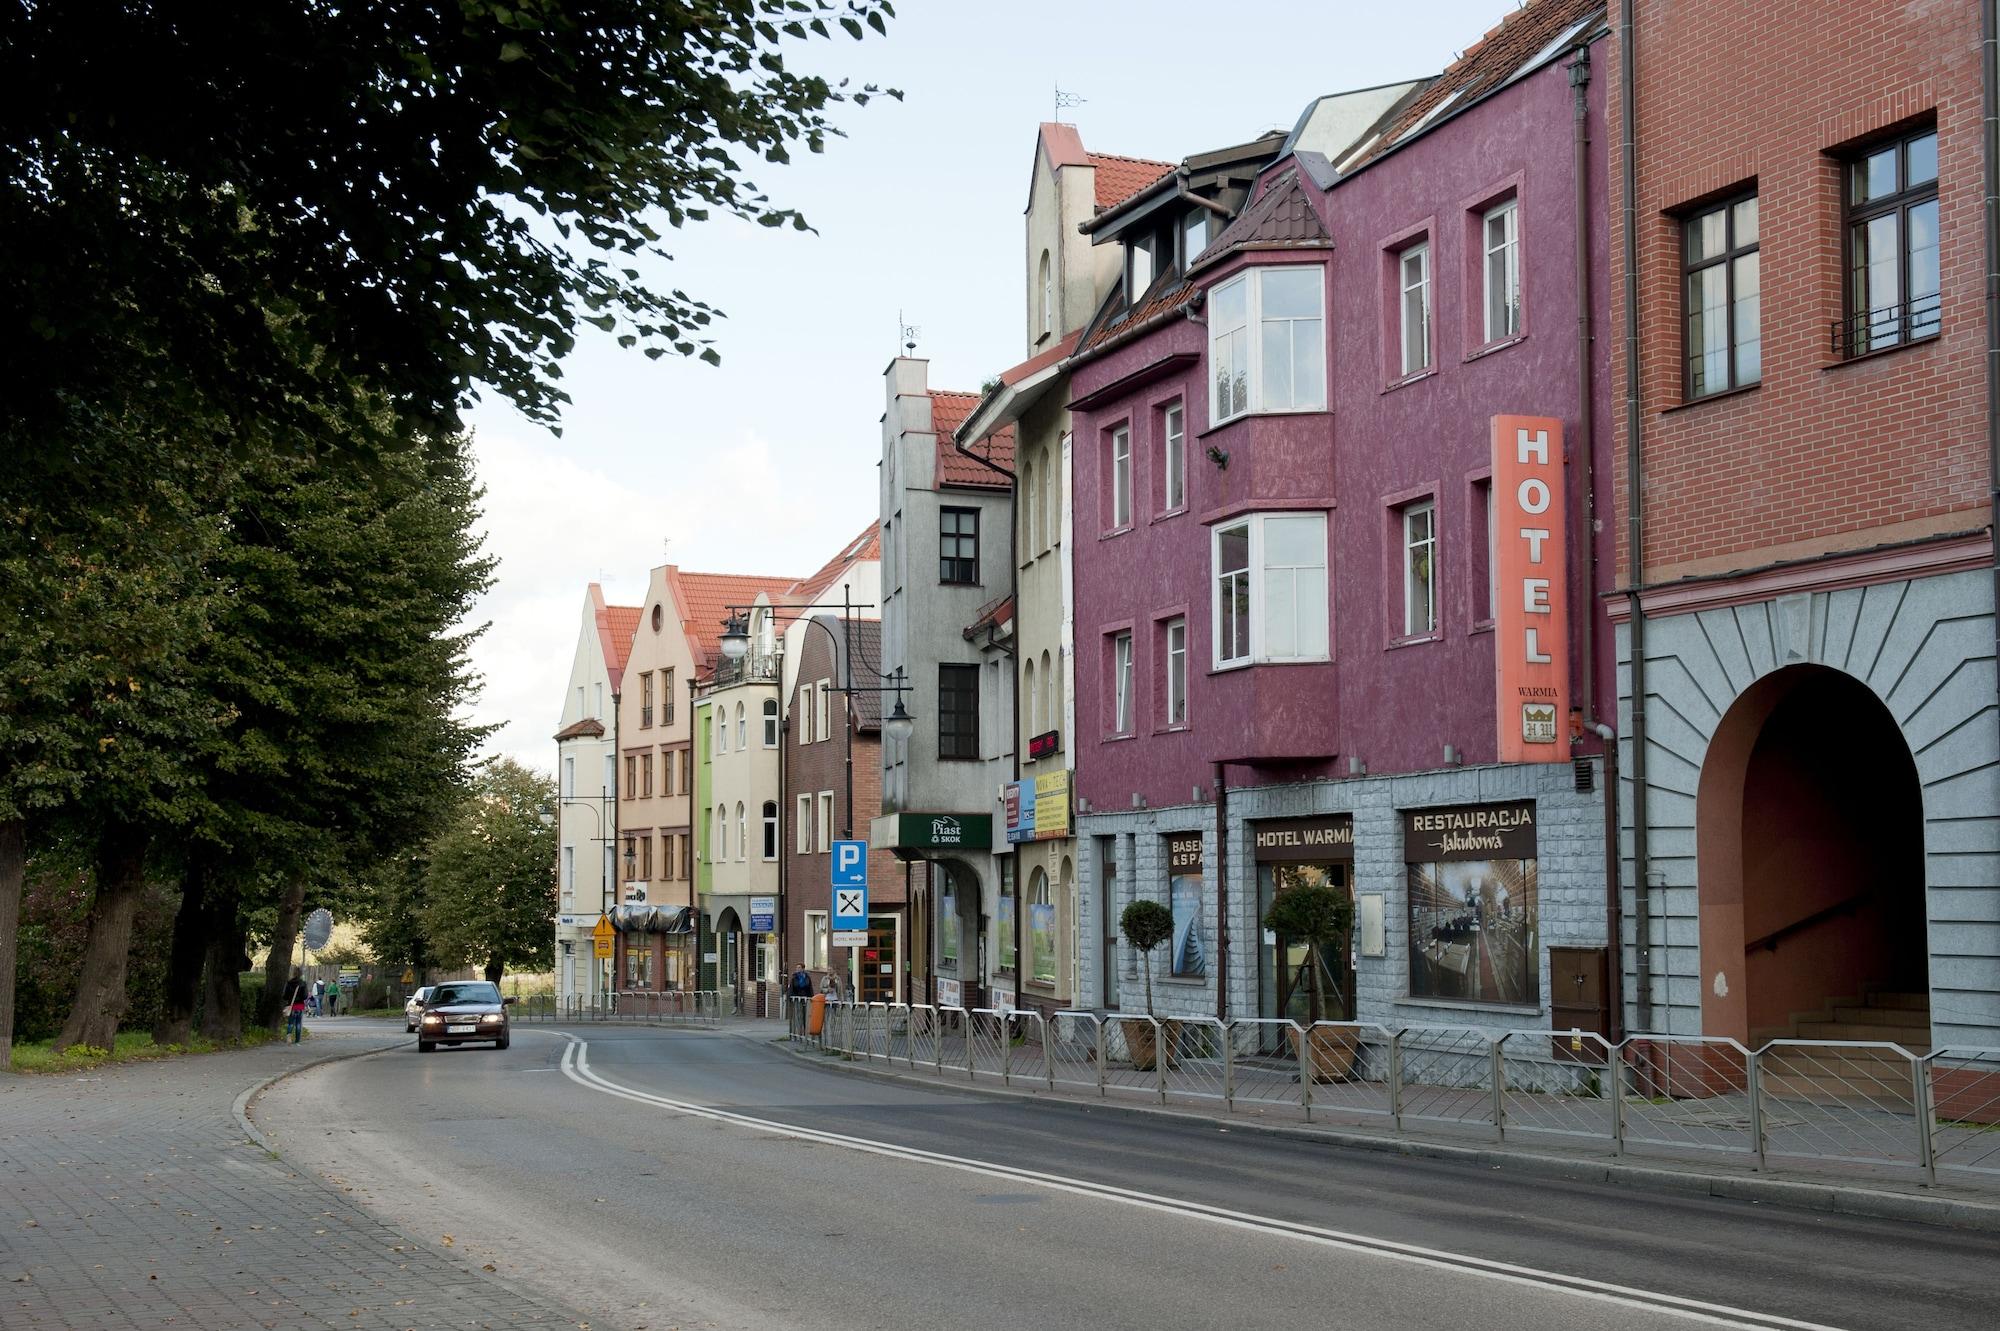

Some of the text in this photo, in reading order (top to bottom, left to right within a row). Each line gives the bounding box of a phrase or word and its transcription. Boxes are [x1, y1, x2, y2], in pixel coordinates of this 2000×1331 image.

[1516, 427, 1552, 664] HOTEL
[1518, 687, 1558, 697] WARMIA
[931, 821, 961, 835] Piast
[1413, 808, 1532, 831] RESTAURACJA
[1256, 831, 1301, 847] HOTEL
[1428, 828, 1512, 855] Jakubowa
[840, 845, 859, 872] P
